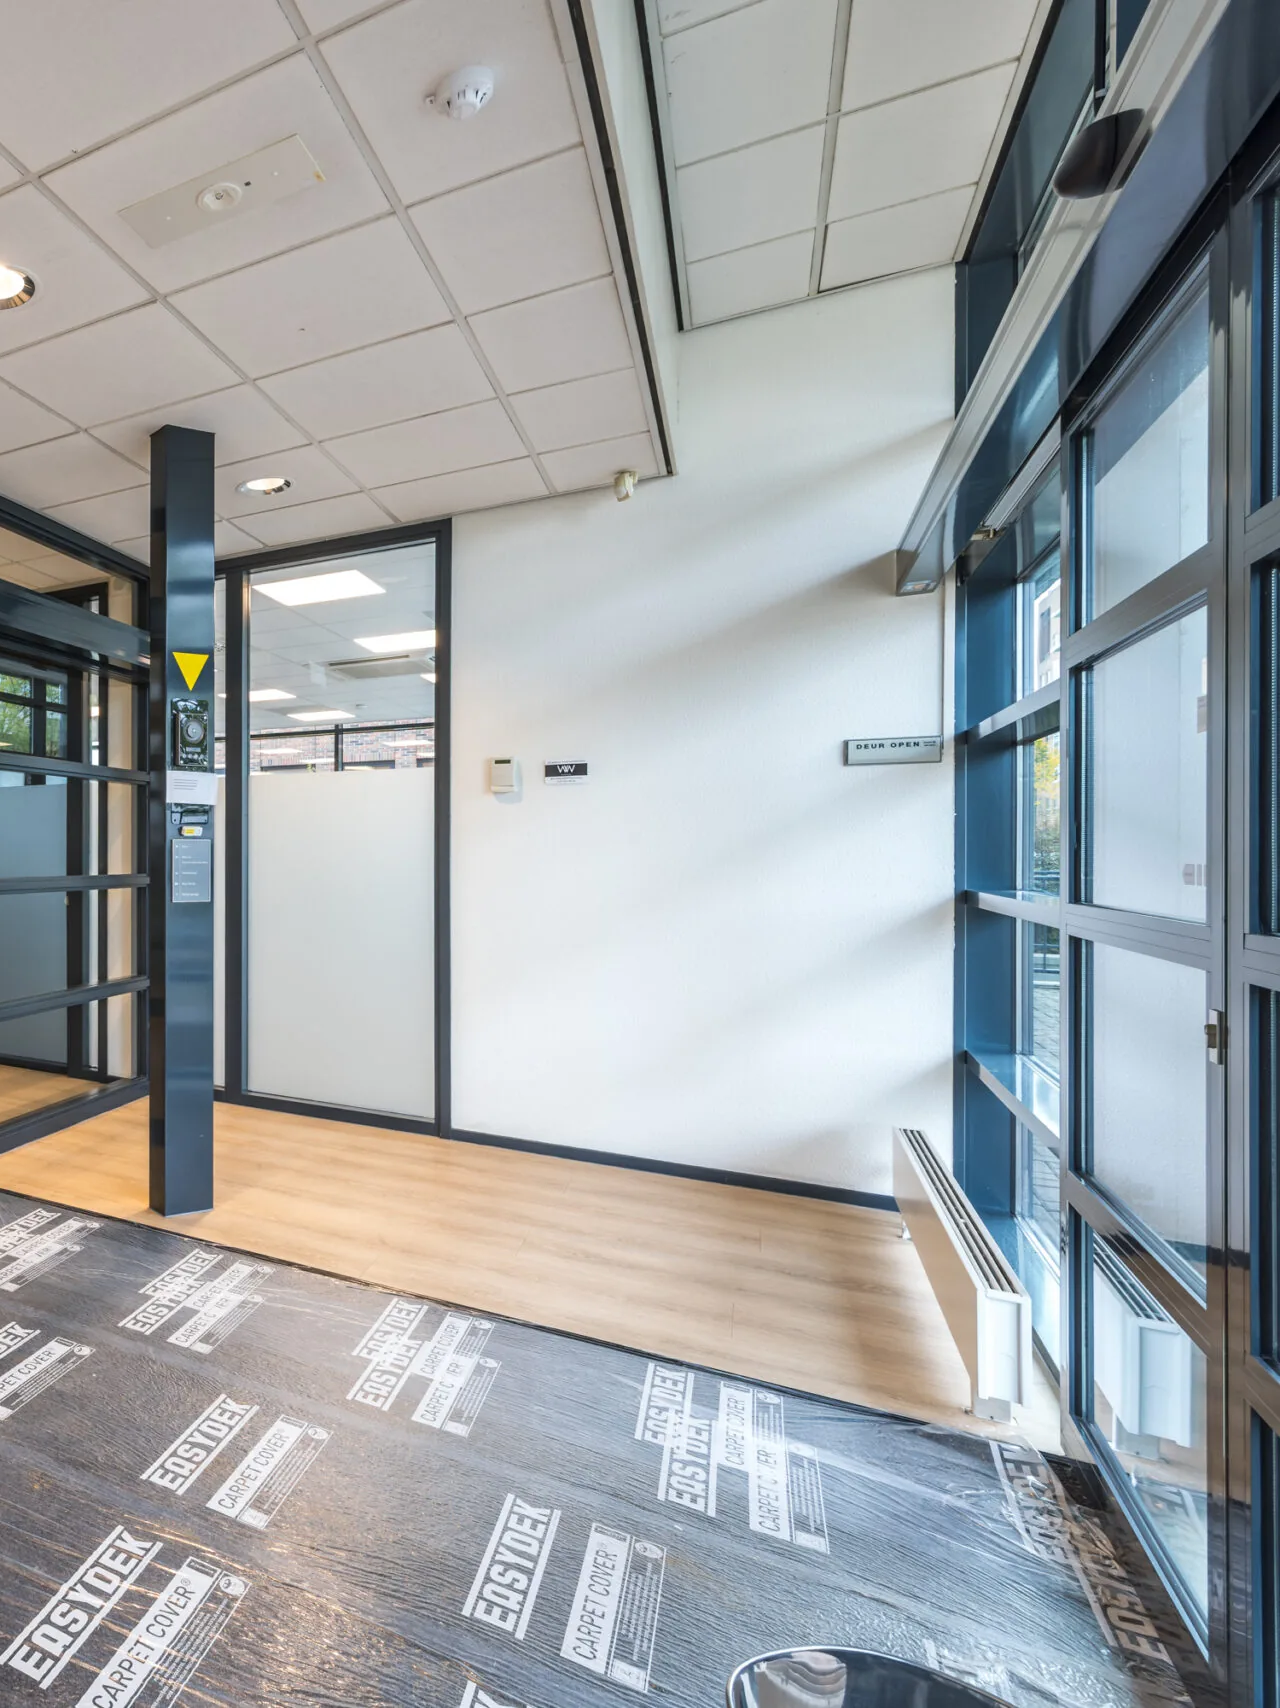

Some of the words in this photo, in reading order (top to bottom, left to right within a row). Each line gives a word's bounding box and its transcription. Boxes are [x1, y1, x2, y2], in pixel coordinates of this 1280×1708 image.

[148, 1398, 253, 1491] EASYDEK
[725, 1427, 745, 1466] CARPET
[217, 1463, 261, 1510] CARPET
[757, 1485, 781, 1533] CARPET
[474, 1498, 551, 1632] EASYDEK
[8, 1529, 156, 1682] EASYDEK
[573, 1595, 606, 1661] CARPET
